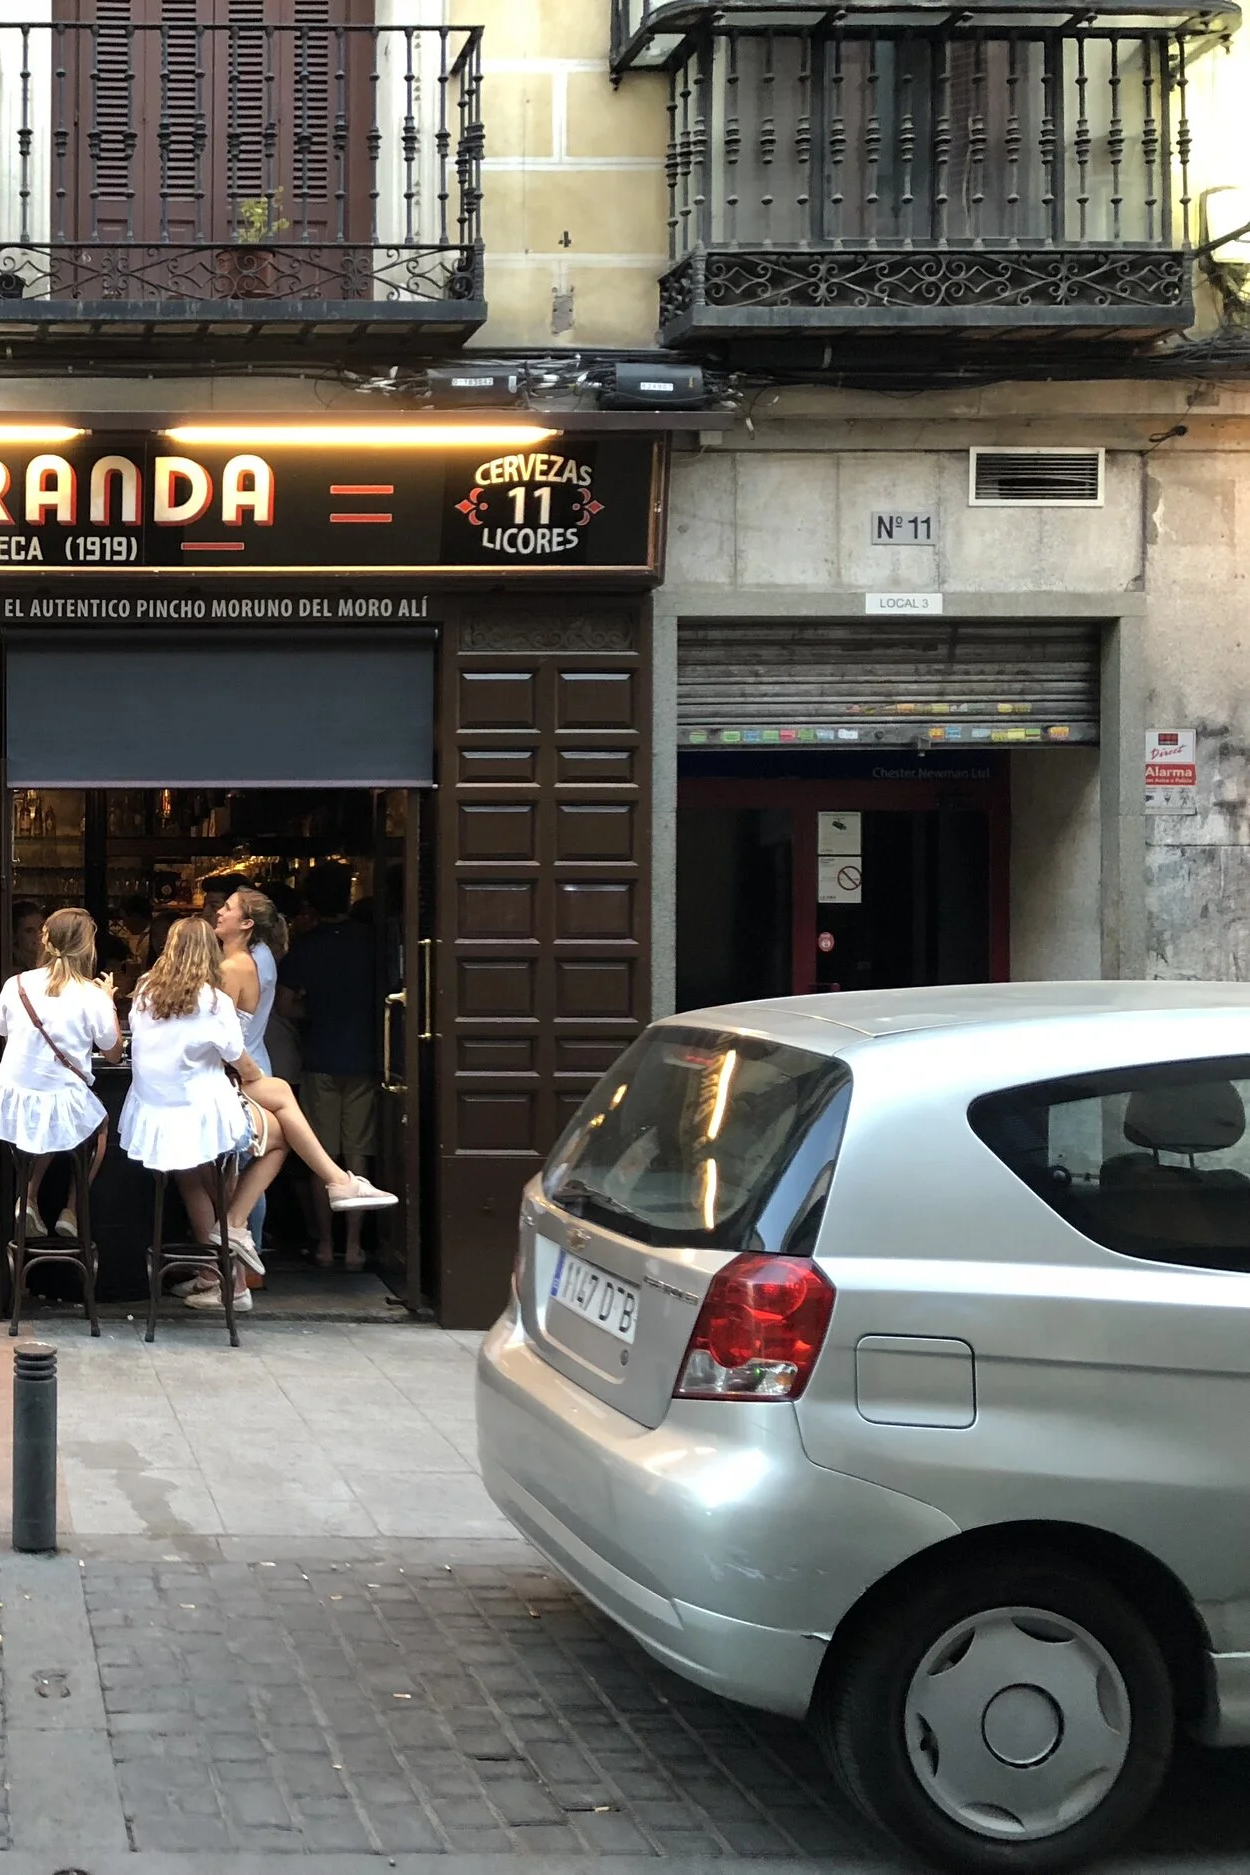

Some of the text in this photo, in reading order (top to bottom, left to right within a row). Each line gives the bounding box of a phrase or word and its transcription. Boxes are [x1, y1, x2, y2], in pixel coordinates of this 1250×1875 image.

[474, 453, 593, 486] CERVEZAS
[508, 486, 551, 525] 11
[908, 516, 931, 540] 11
[65, 537, 138, 562] (1919)
[482, 527, 579, 554] LICORES
[4, 595, 428, 618] EL AUTENTICO PINCHO MORUNO DEL MORO ALÍ
[880, 597, 929, 609] LOCAL 3
[872, 767, 917, 779] Chester
[918, 768, 969, 779] Newman
[1145, 765, 1192, 778] Alarma
